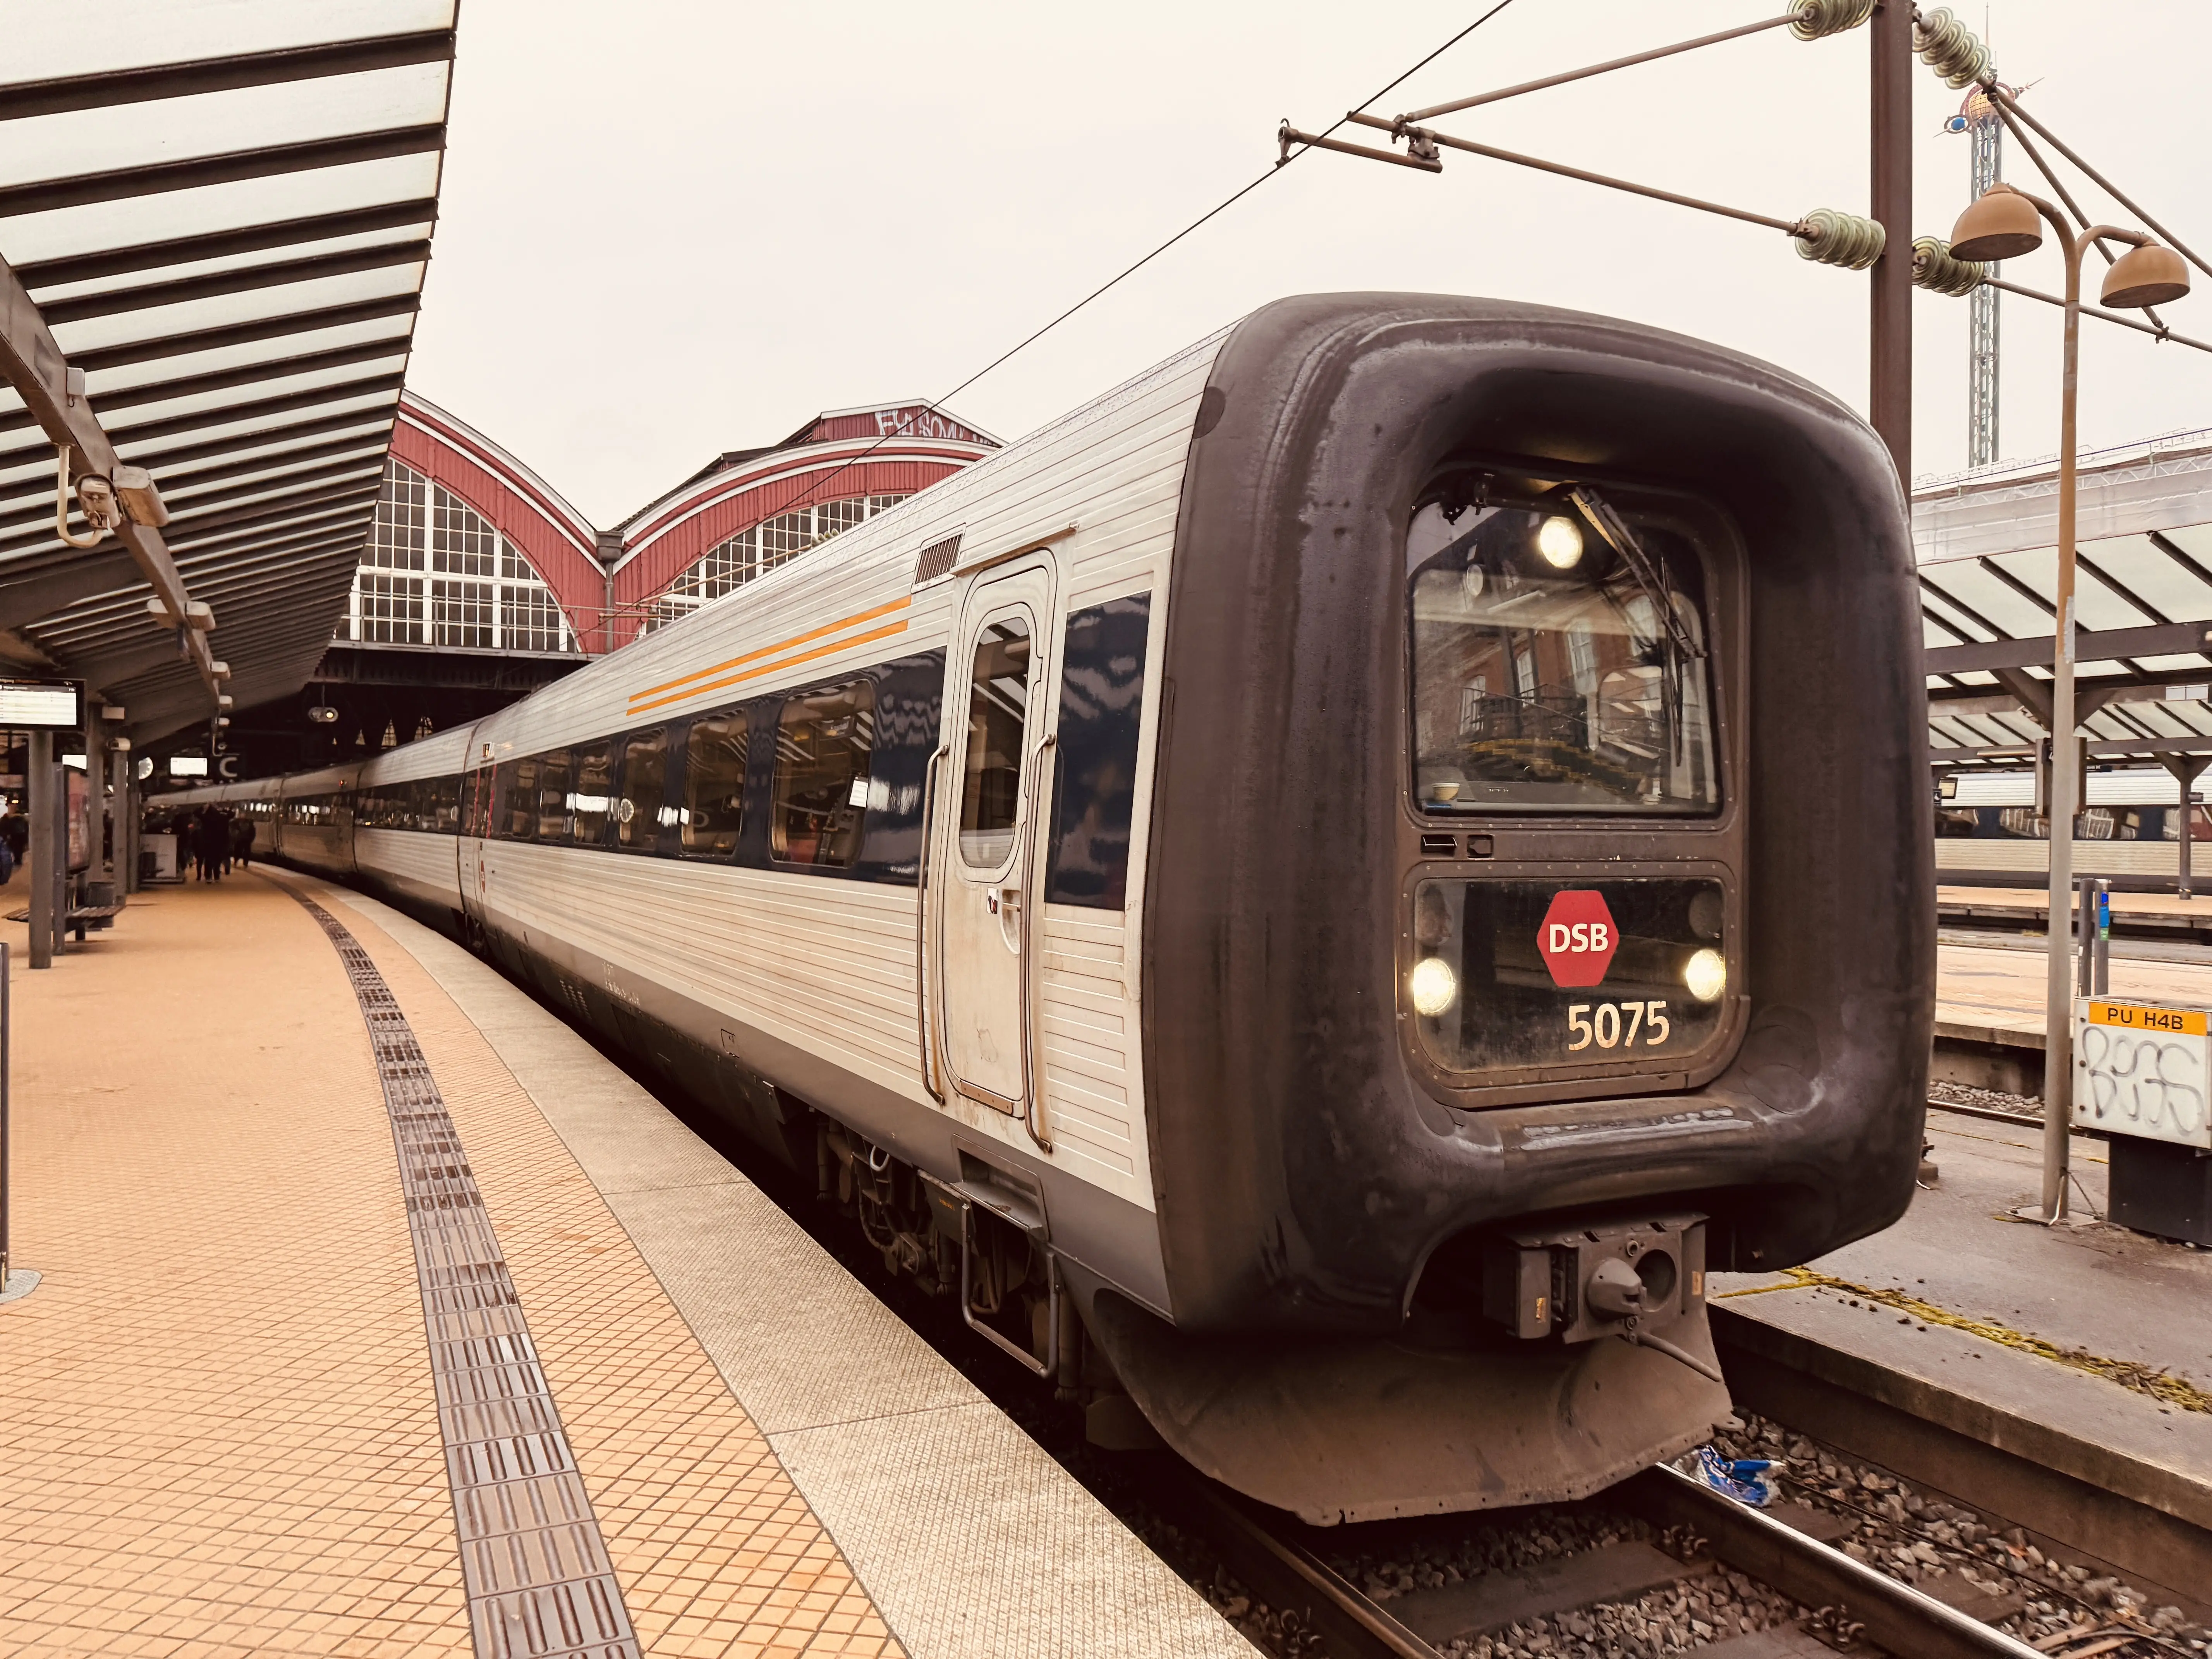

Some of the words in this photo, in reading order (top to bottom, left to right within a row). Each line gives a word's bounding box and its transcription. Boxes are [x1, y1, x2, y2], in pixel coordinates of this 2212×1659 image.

[1549, 923, 1608, 953] DSB
[1568, 1001, 1669, 1051] 5075
[2107, 1008, 2132, 1024] PU
[2144, 1012, 2183, 1030] H4B
